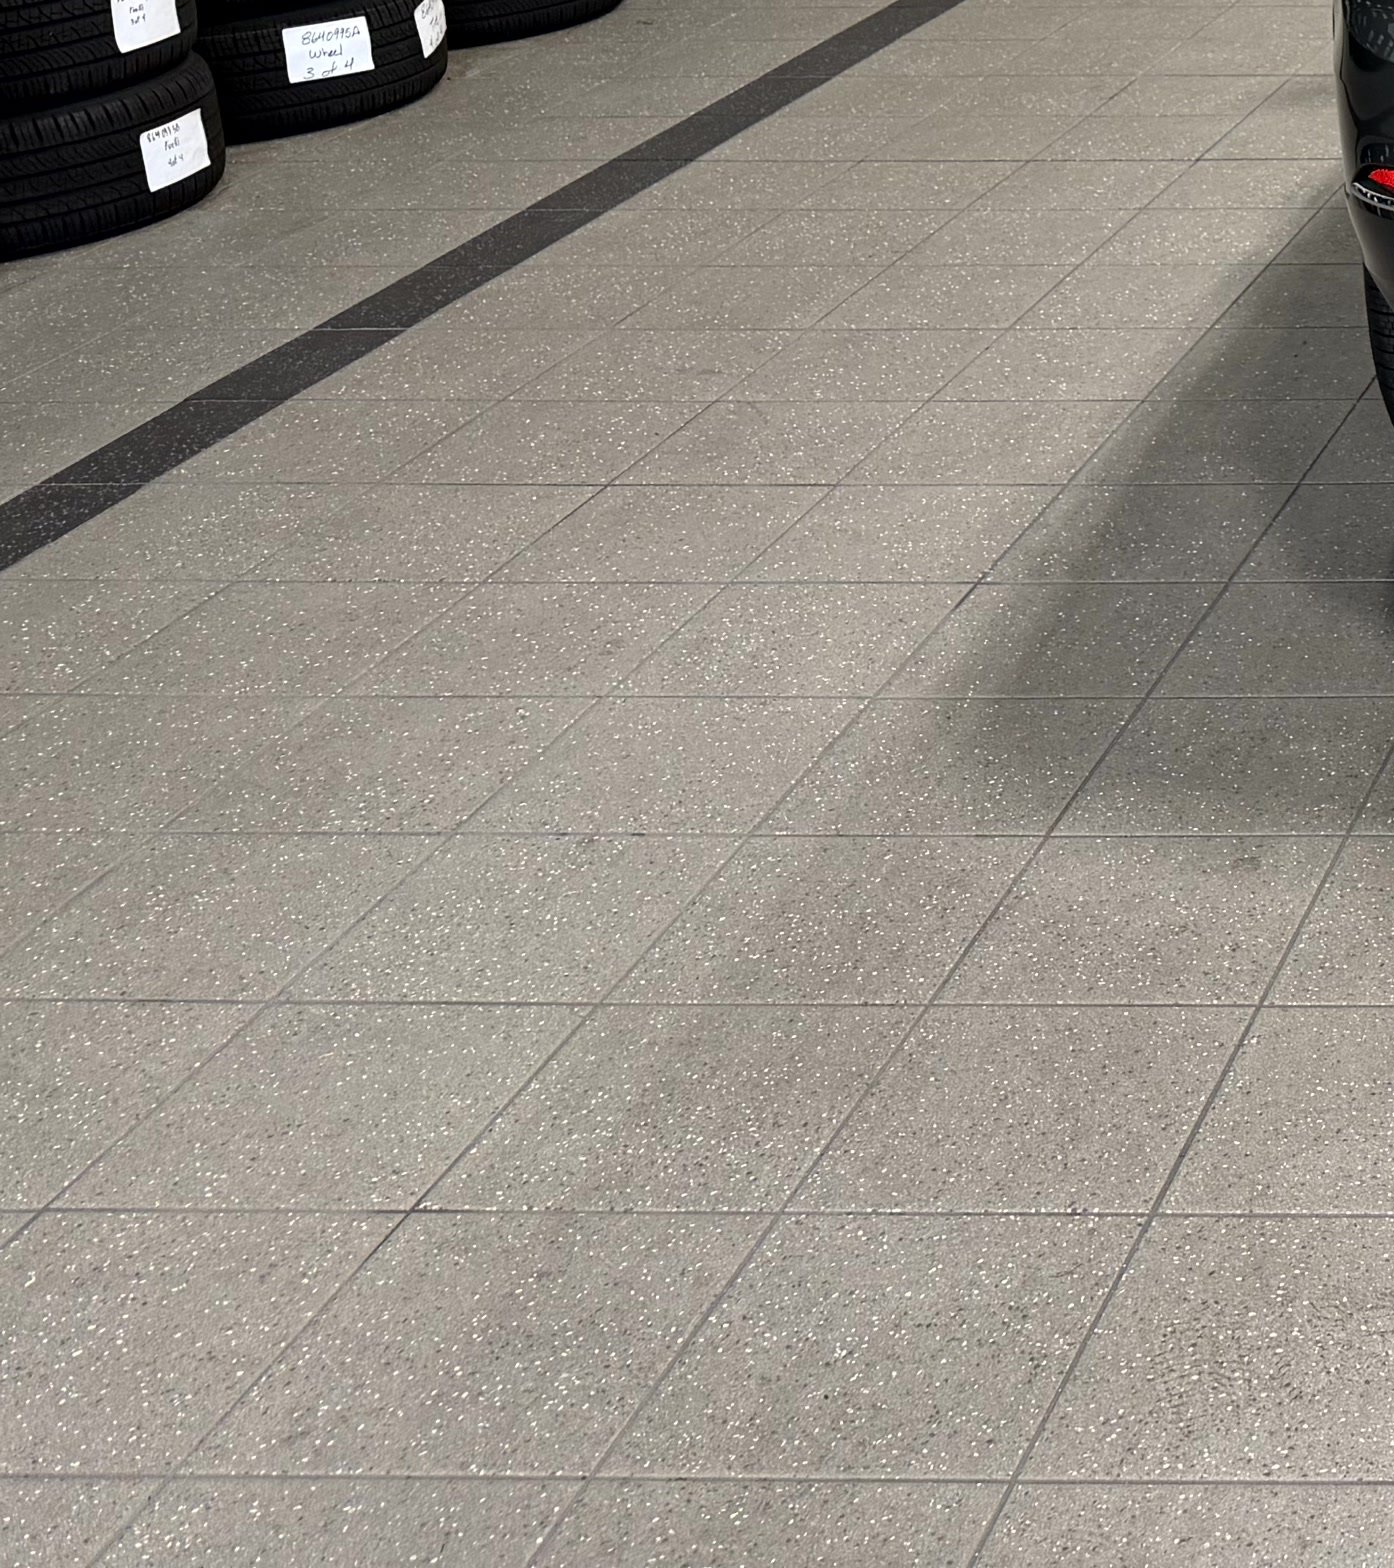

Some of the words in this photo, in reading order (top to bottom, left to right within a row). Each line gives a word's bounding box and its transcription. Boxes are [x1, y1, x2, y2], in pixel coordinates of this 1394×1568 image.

[303, 67, 315, 80] 3
[321, 60, 338, 78] of
[344, 57, 354, 70] 4
